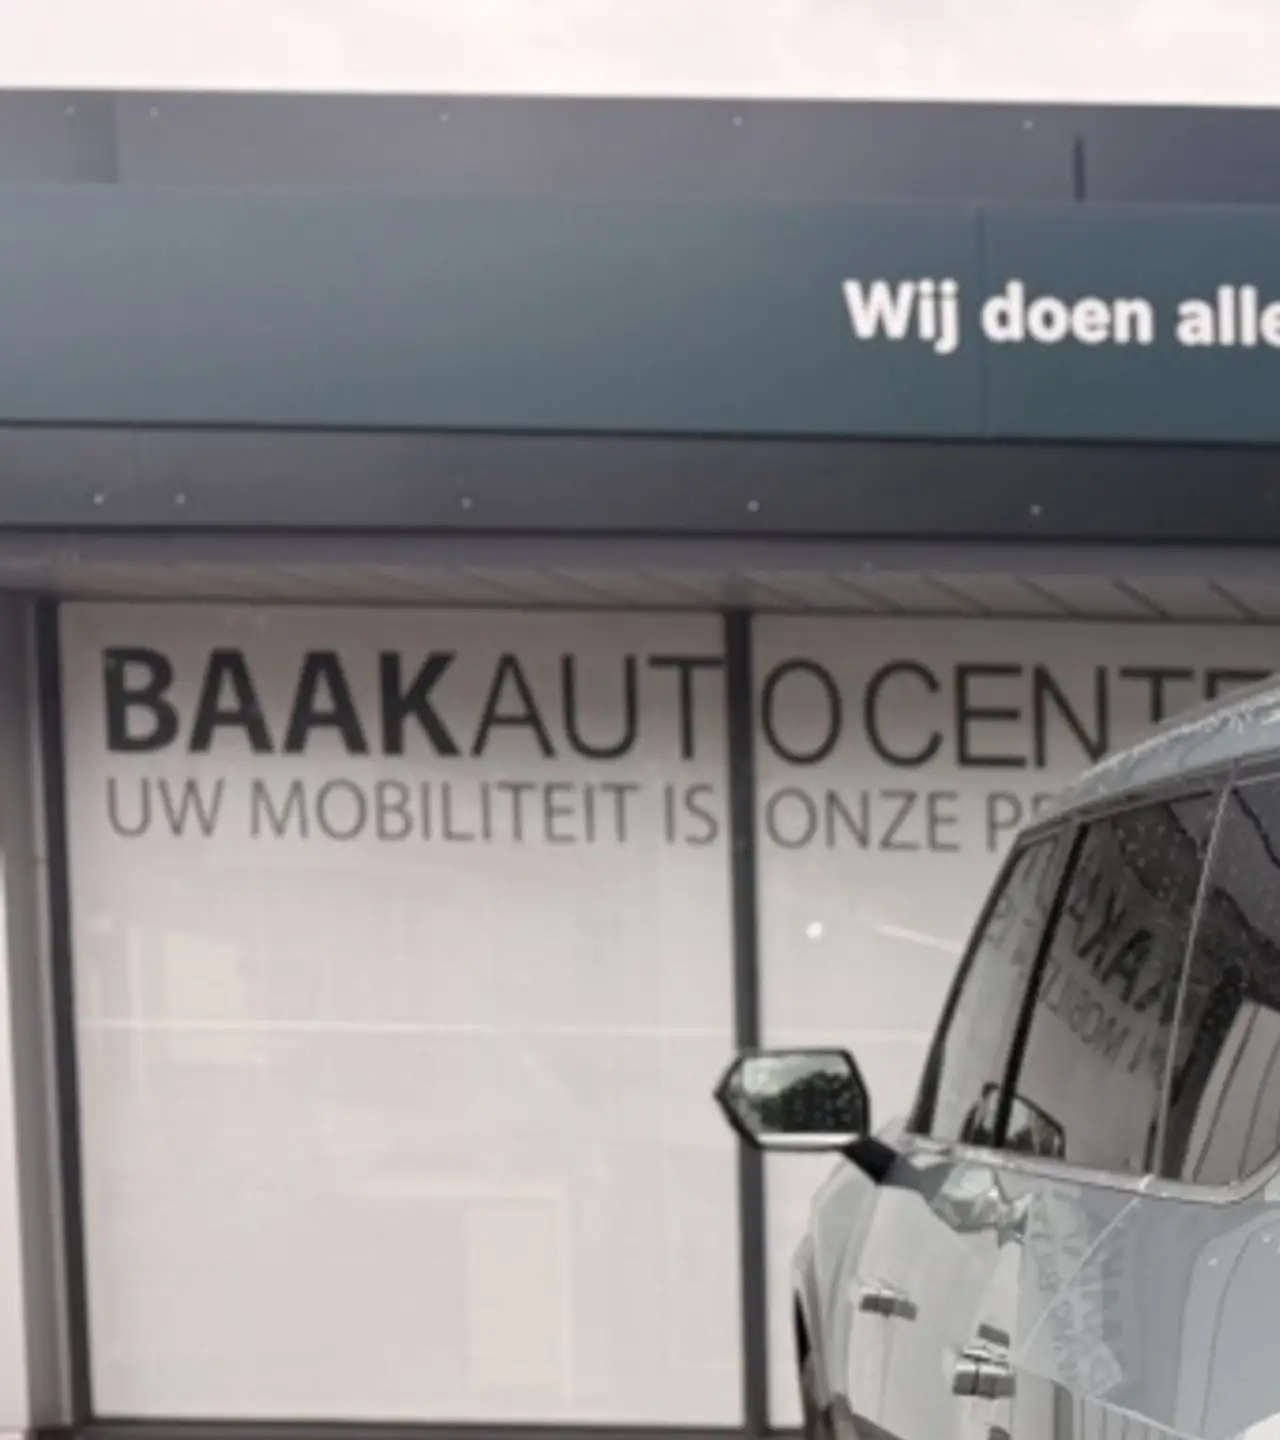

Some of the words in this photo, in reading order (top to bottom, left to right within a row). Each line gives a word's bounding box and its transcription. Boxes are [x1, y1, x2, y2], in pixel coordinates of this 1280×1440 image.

[842, 278, 959, 355] Wij
[980, 278, 1154, 344] doen
[105, 776, 226, 839] UW
[249, 777, 641, 843] MOBILITEIT
[663, 782, 721, 846] IS
[764, 785, 960, 853] ONZE
